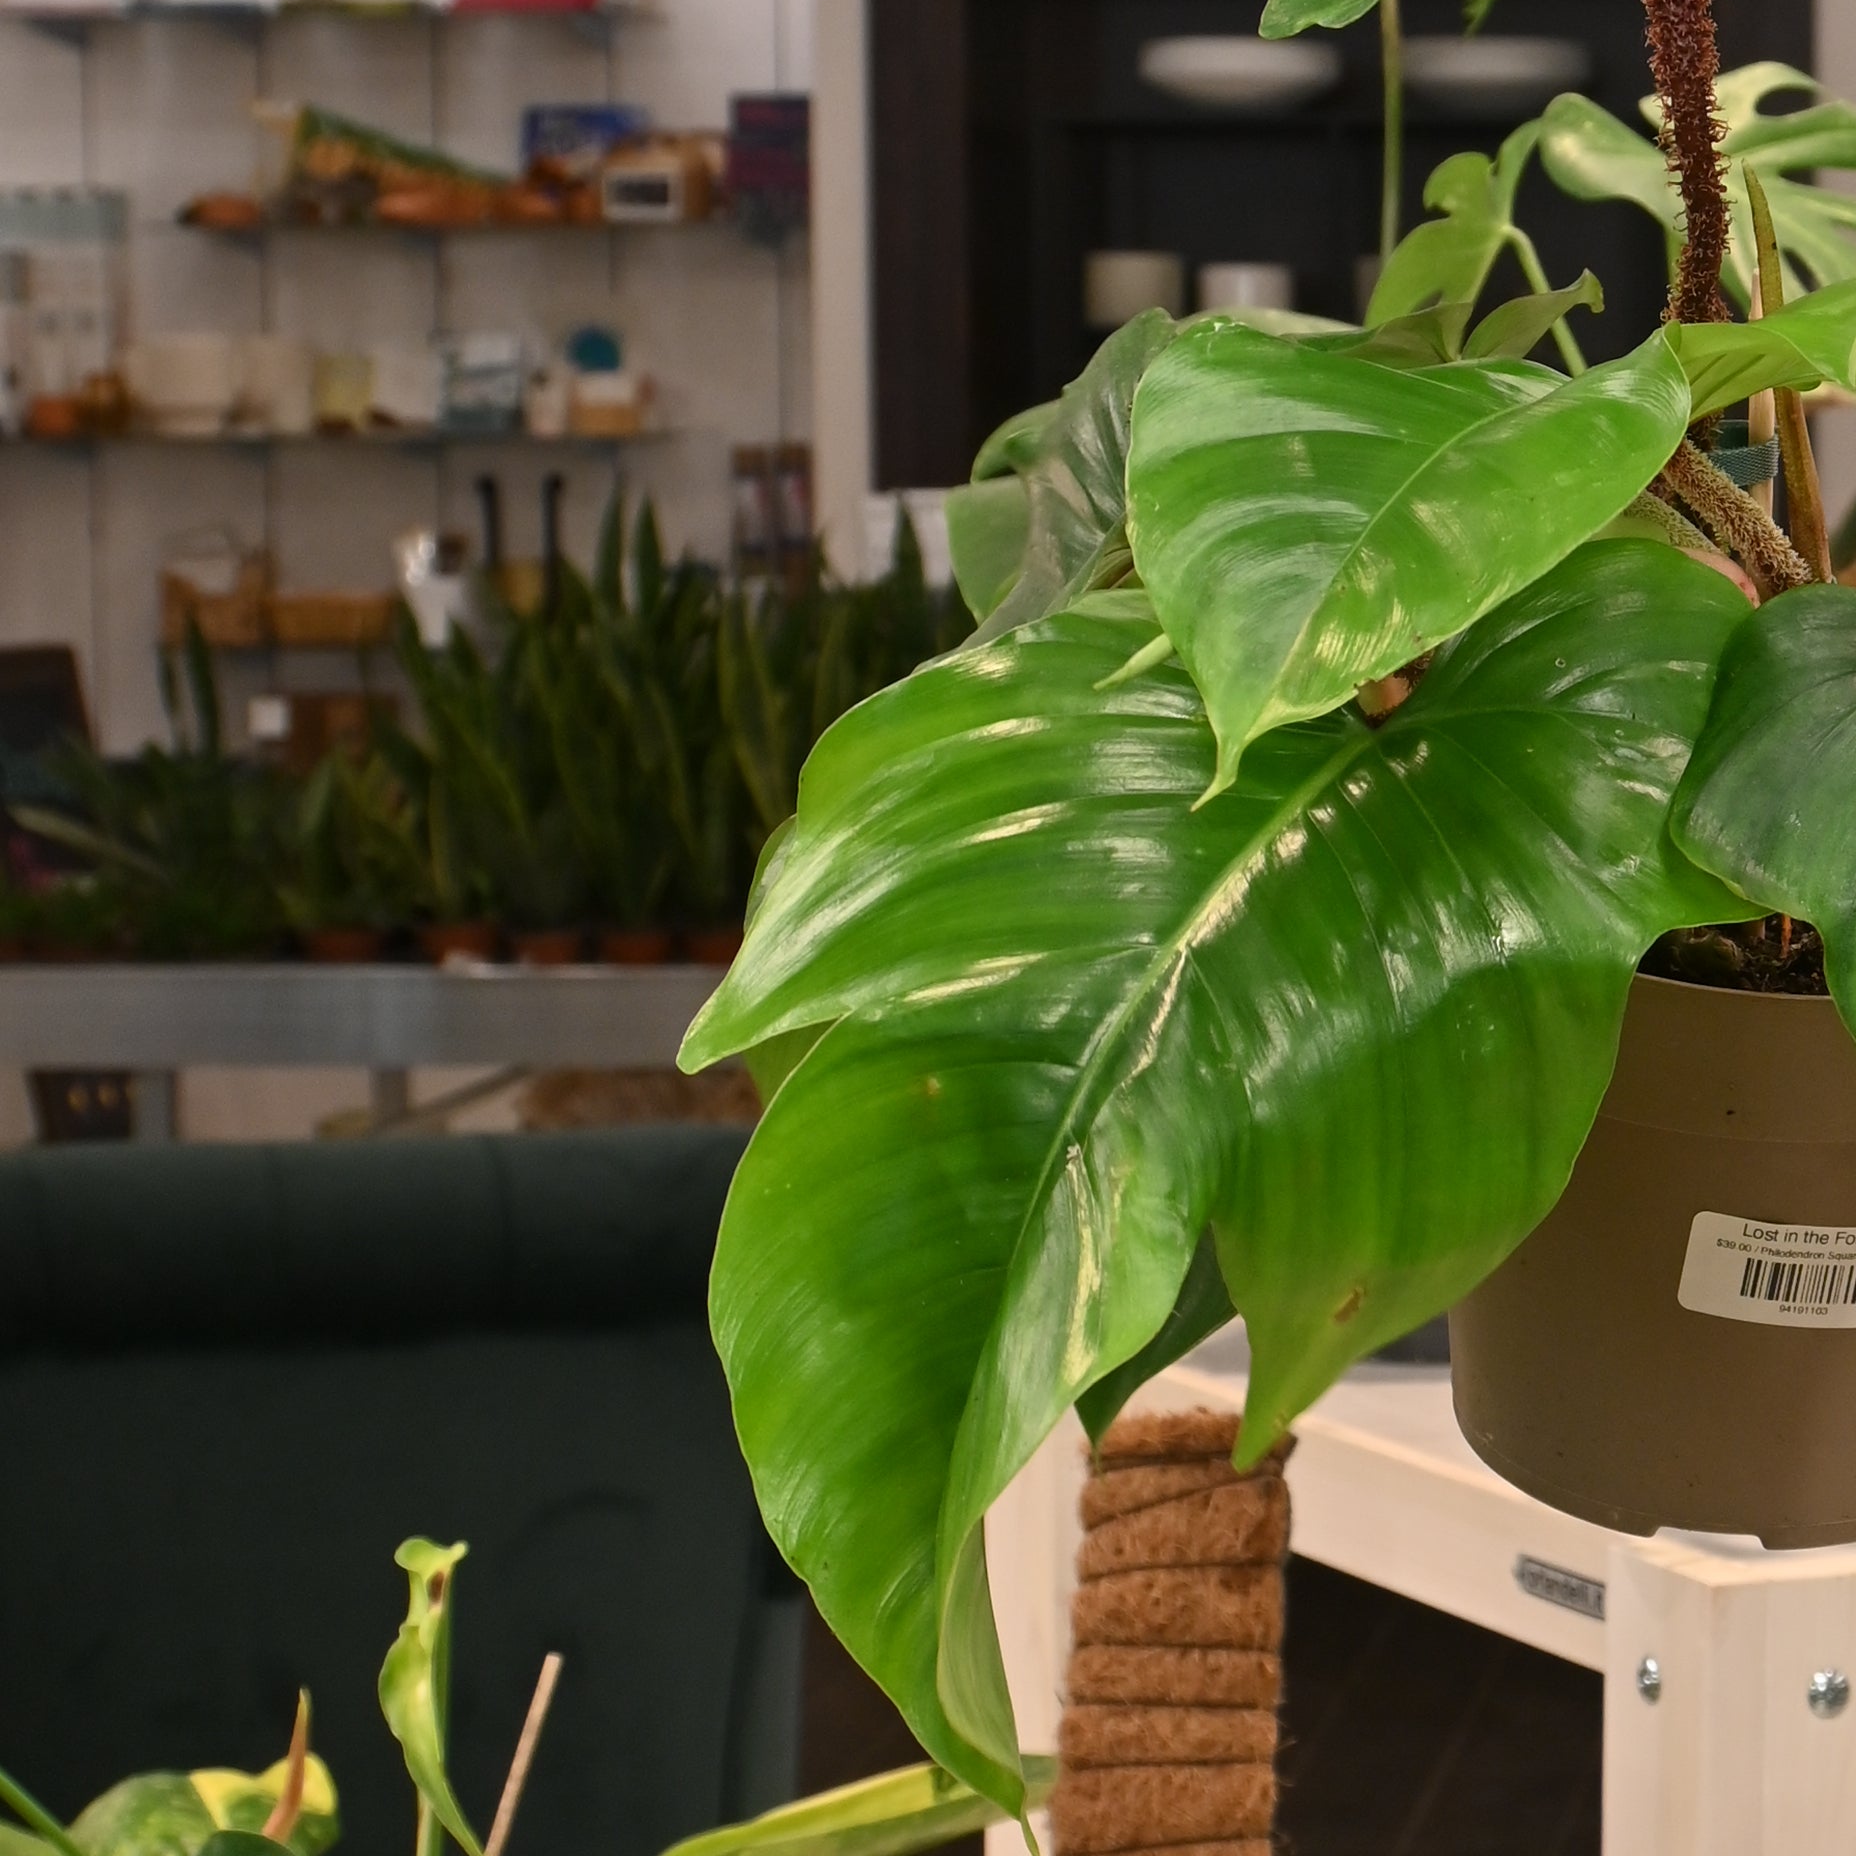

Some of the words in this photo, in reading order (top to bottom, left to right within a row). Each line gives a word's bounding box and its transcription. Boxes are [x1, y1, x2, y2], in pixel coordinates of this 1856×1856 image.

[1743, 1223, 1779, 1242] Lost
[1784, 1228, 1799, 1243] in
[1803, 1230, 1830, 1245] the
